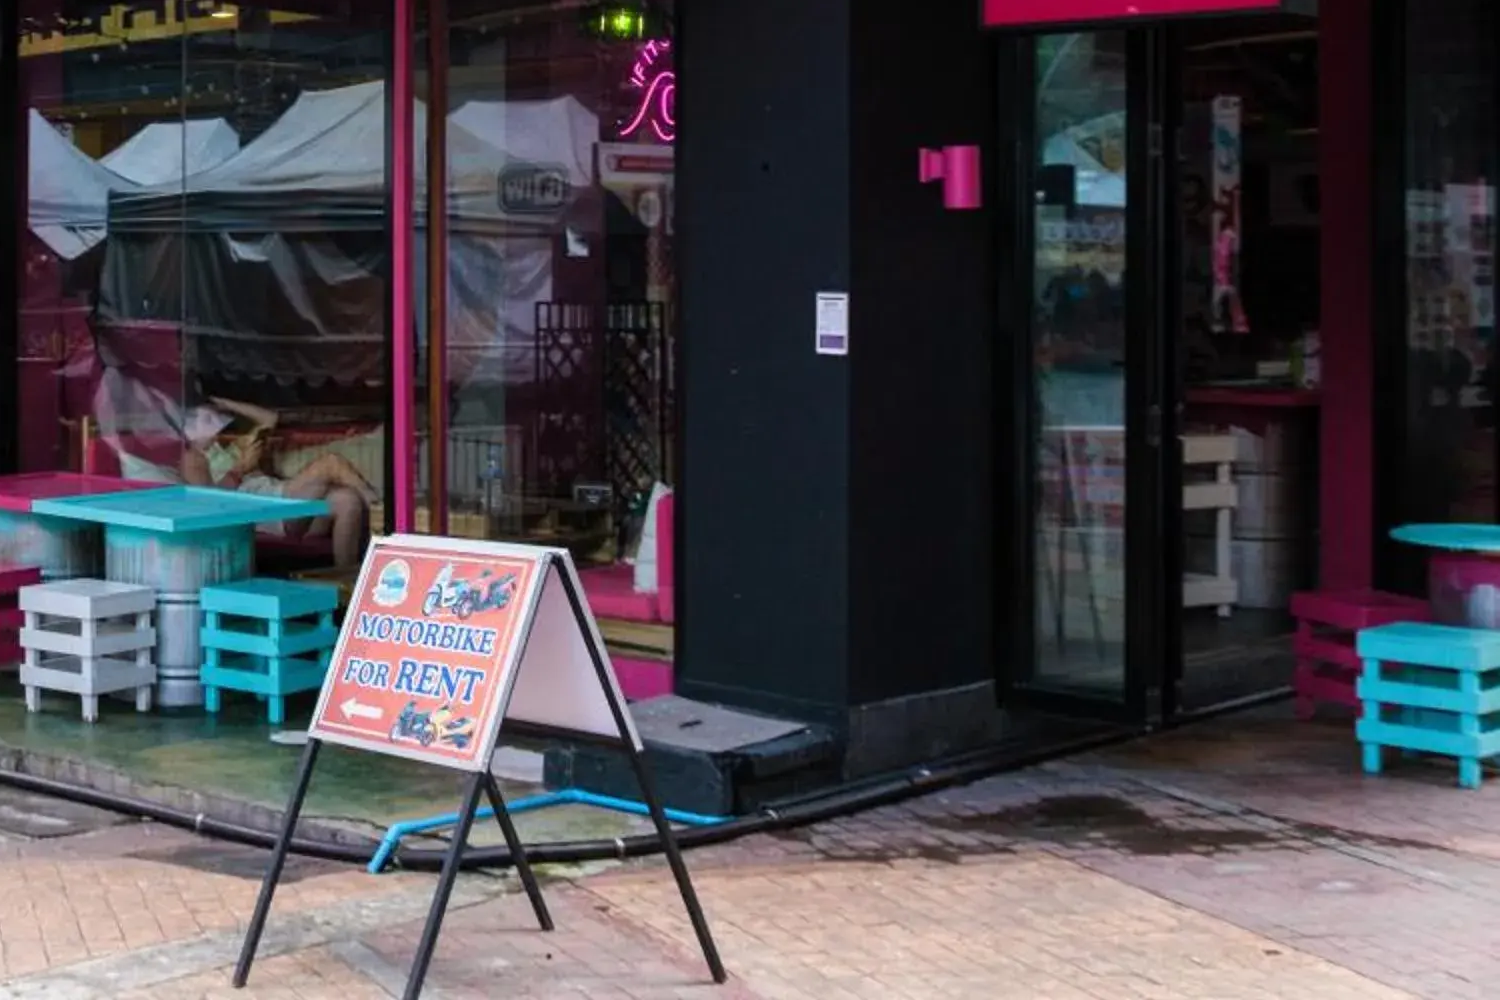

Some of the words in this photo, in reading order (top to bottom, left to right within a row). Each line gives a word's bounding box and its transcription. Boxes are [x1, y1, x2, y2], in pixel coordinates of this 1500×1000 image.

[355, 612, 497, 655] MOTORBIKE
[344, 657, 390, 688] FOR
[394, 658, 486, 702] RENT
